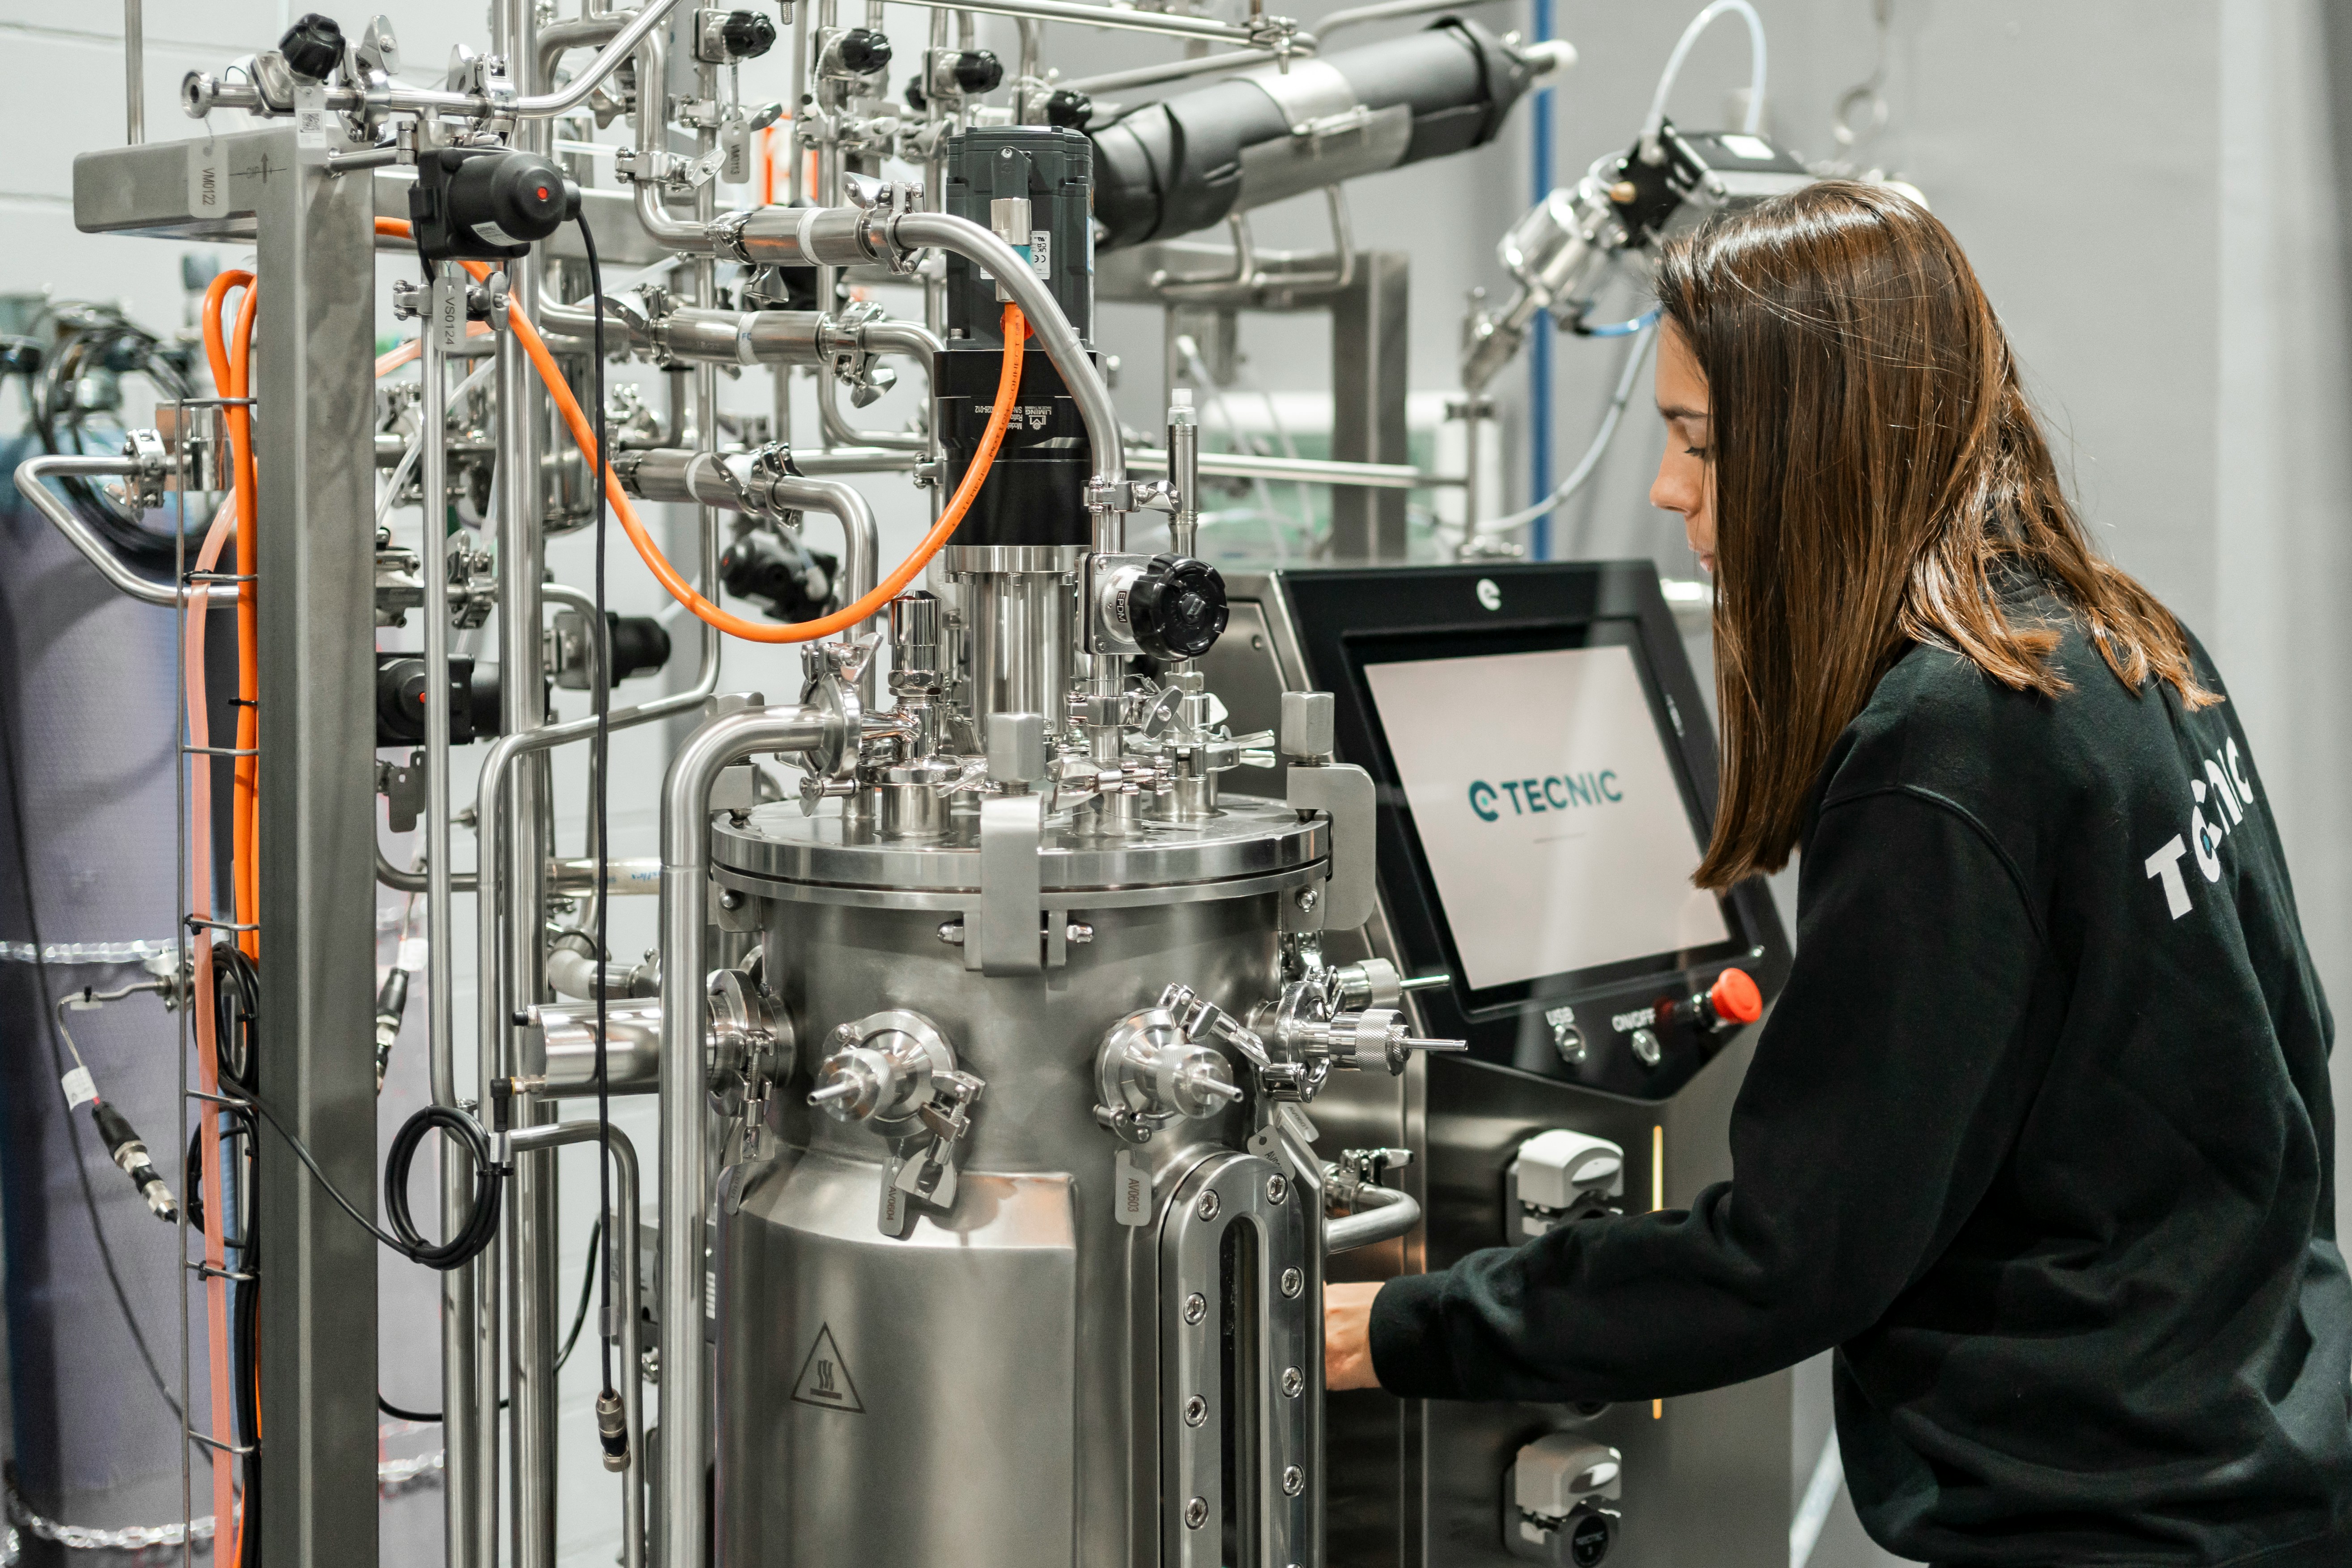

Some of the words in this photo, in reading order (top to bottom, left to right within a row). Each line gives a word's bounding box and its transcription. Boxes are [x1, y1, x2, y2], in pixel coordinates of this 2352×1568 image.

[202, 167, 216, 206] VM0122
[445, 296, 455, 345] VS0124
[1117, 592, 1127, 622] EPDM
[1501, 769, 1623, 815] TECNIC
[1545, 1006, 1575, 1027] USB
[1127, 1177, 1140, 1212] AV0603
